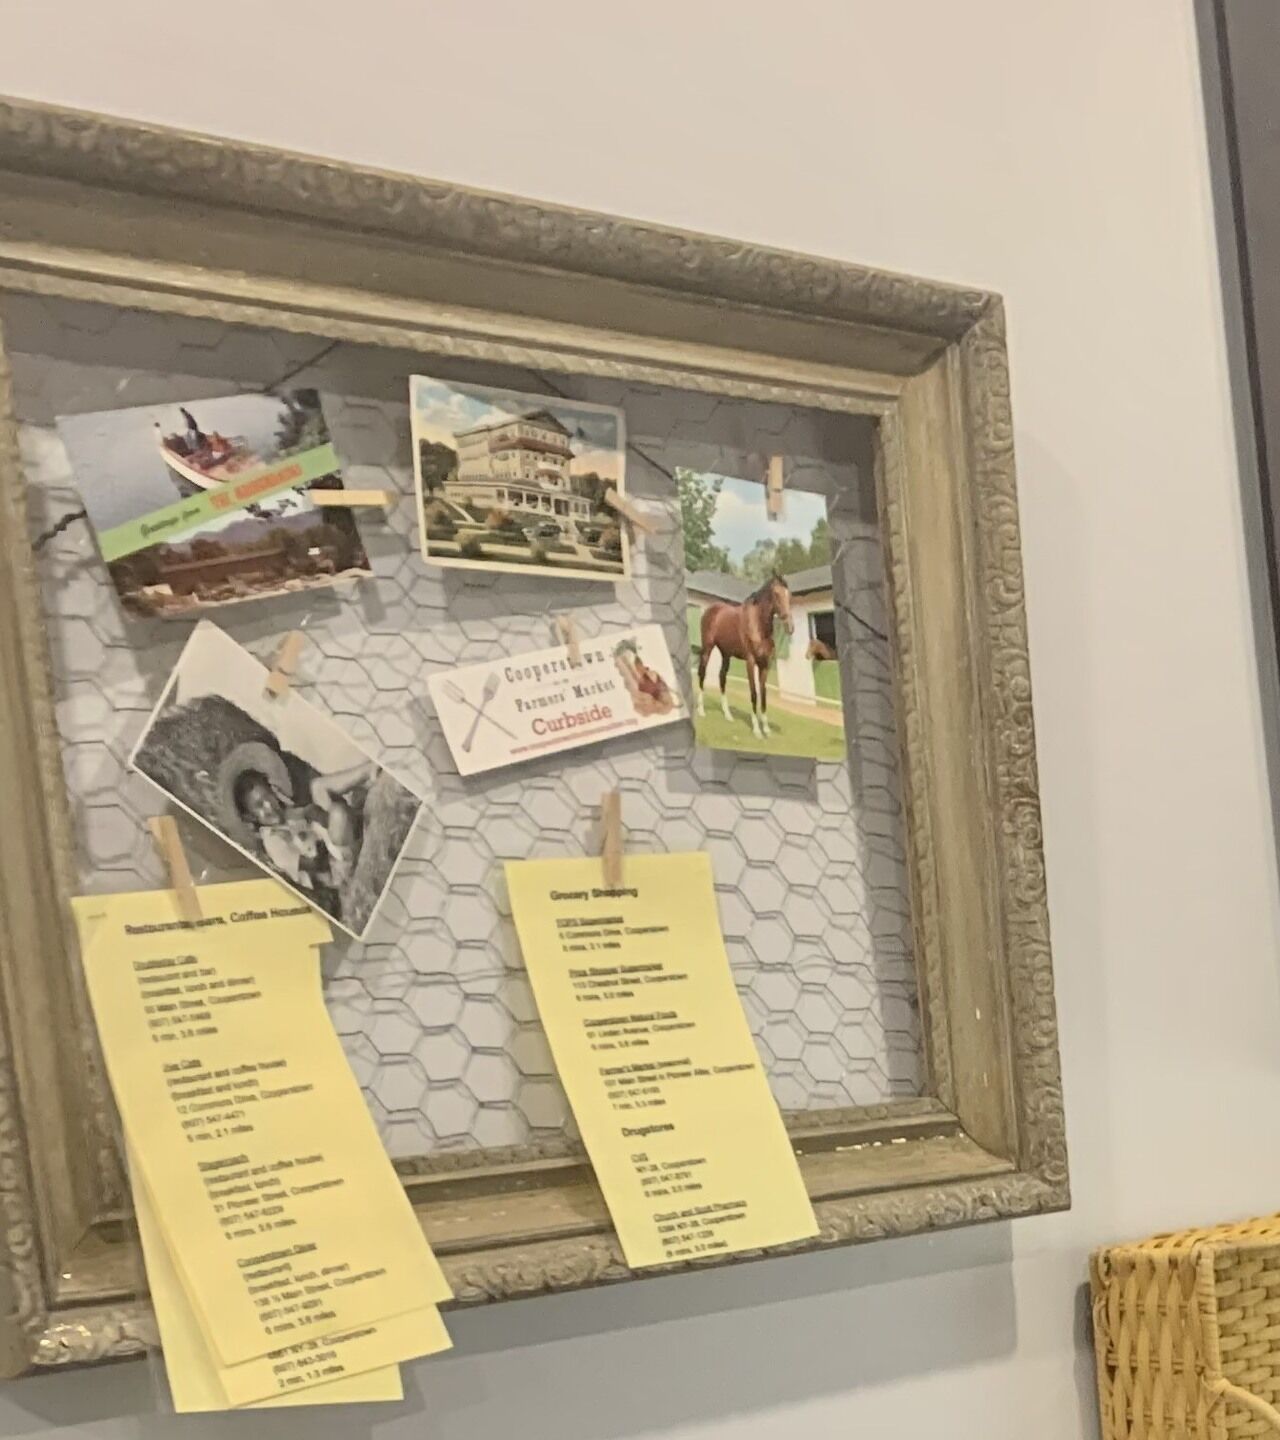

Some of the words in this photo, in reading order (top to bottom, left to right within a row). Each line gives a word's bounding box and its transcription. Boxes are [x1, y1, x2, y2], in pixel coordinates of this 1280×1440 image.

[572, 680, 616, 699] Market
[532, 704, 612, 735] Curbside
[550, 890, 589, 901] Grocery
[591, 888, 638, 898] Shopping
[230, 910, 268, 923] Coffee
[621, 1123, 675, 1137] Drugstores
